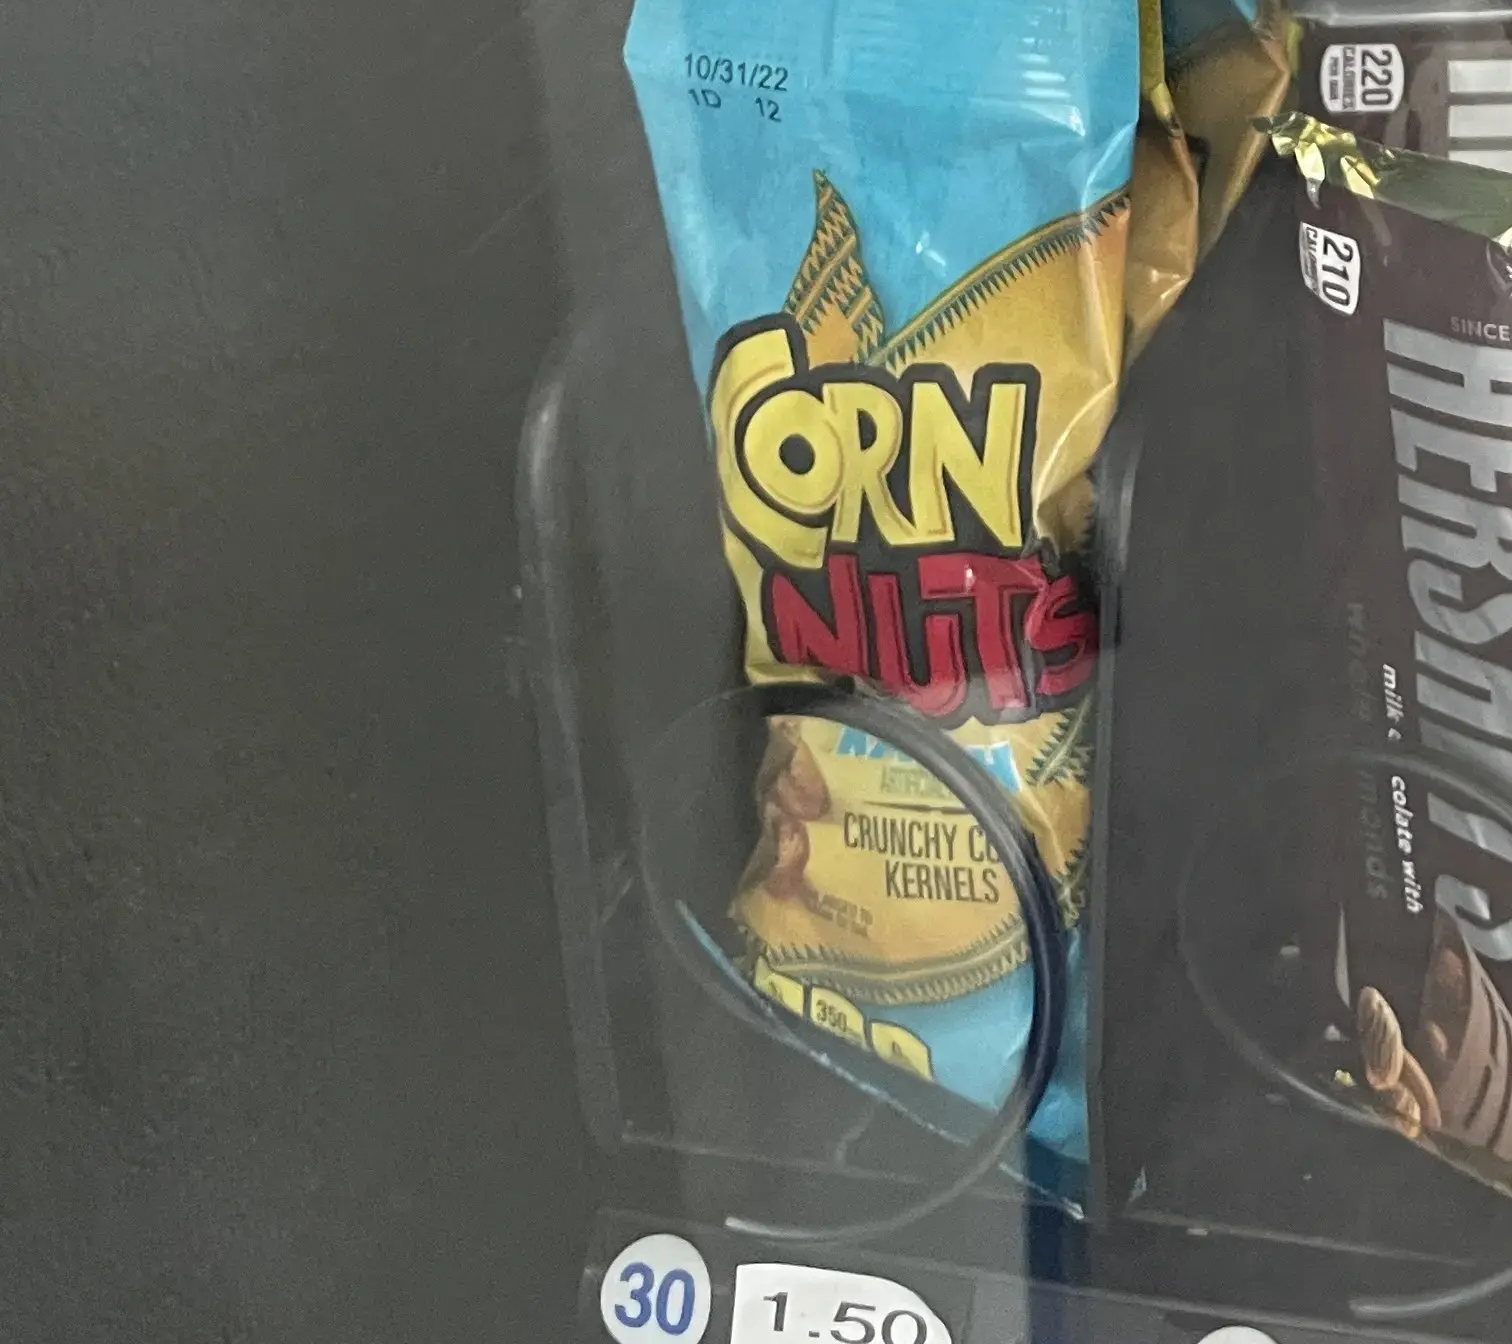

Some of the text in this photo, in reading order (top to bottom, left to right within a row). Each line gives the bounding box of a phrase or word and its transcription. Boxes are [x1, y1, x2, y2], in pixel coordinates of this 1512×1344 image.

[684, 52, 789, 93] 10/31/22
[1360, 48, 1393, 107] 220
[754, 96, 782, 123] 12
[1321, 234, 1354, 308] 210
[1450, 316, 1511, 342] SINCE
[713, 326, 1029, 570] CORN
[770, 552, 1100, 718] NUTS
[1379, 661, 1404, 723] milk
[1399, 858, 1424, 914] with
[843, 811, 958, 862] CRUNCHY
[884, 859, 1001, 904] KERNELS
[815, 999, 847, 1033] 350
[613, 1260, 696, 1335] 30
[762, 1290, 929, 1344] 1.50
